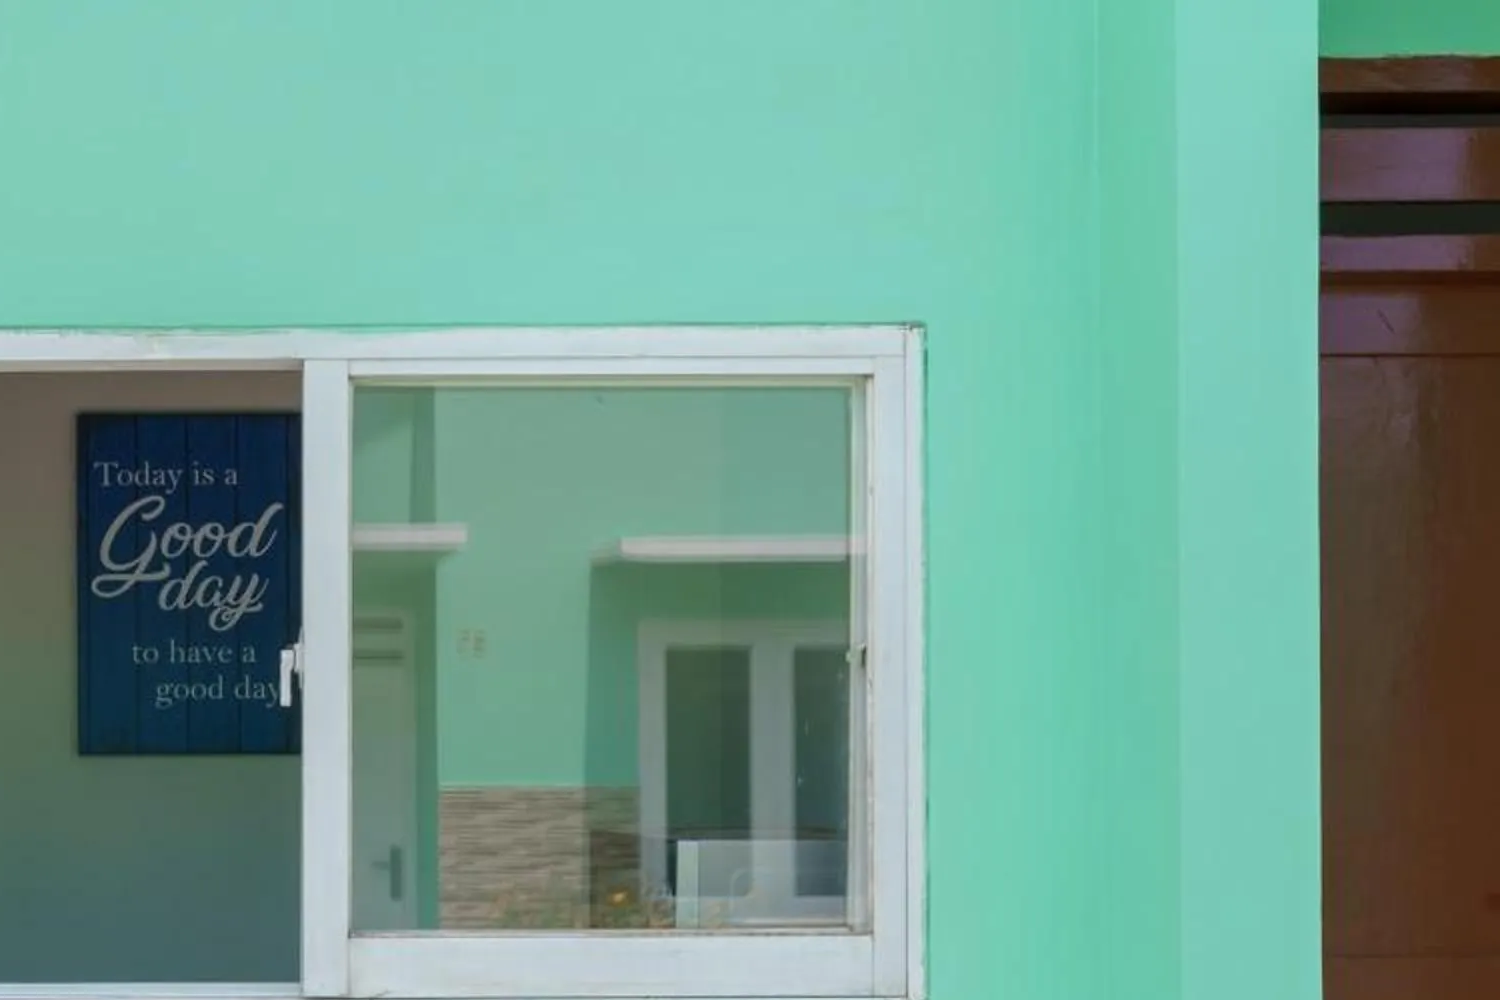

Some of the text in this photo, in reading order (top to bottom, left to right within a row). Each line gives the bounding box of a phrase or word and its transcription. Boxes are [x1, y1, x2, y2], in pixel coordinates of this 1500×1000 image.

[94, 461, 239, 494] Today is a
[91, 495, 284, 598] Good
[158, 560, 269, 631] day
[132, 639, 256, 664] to have a
[155, 675, 281, 709] good day
